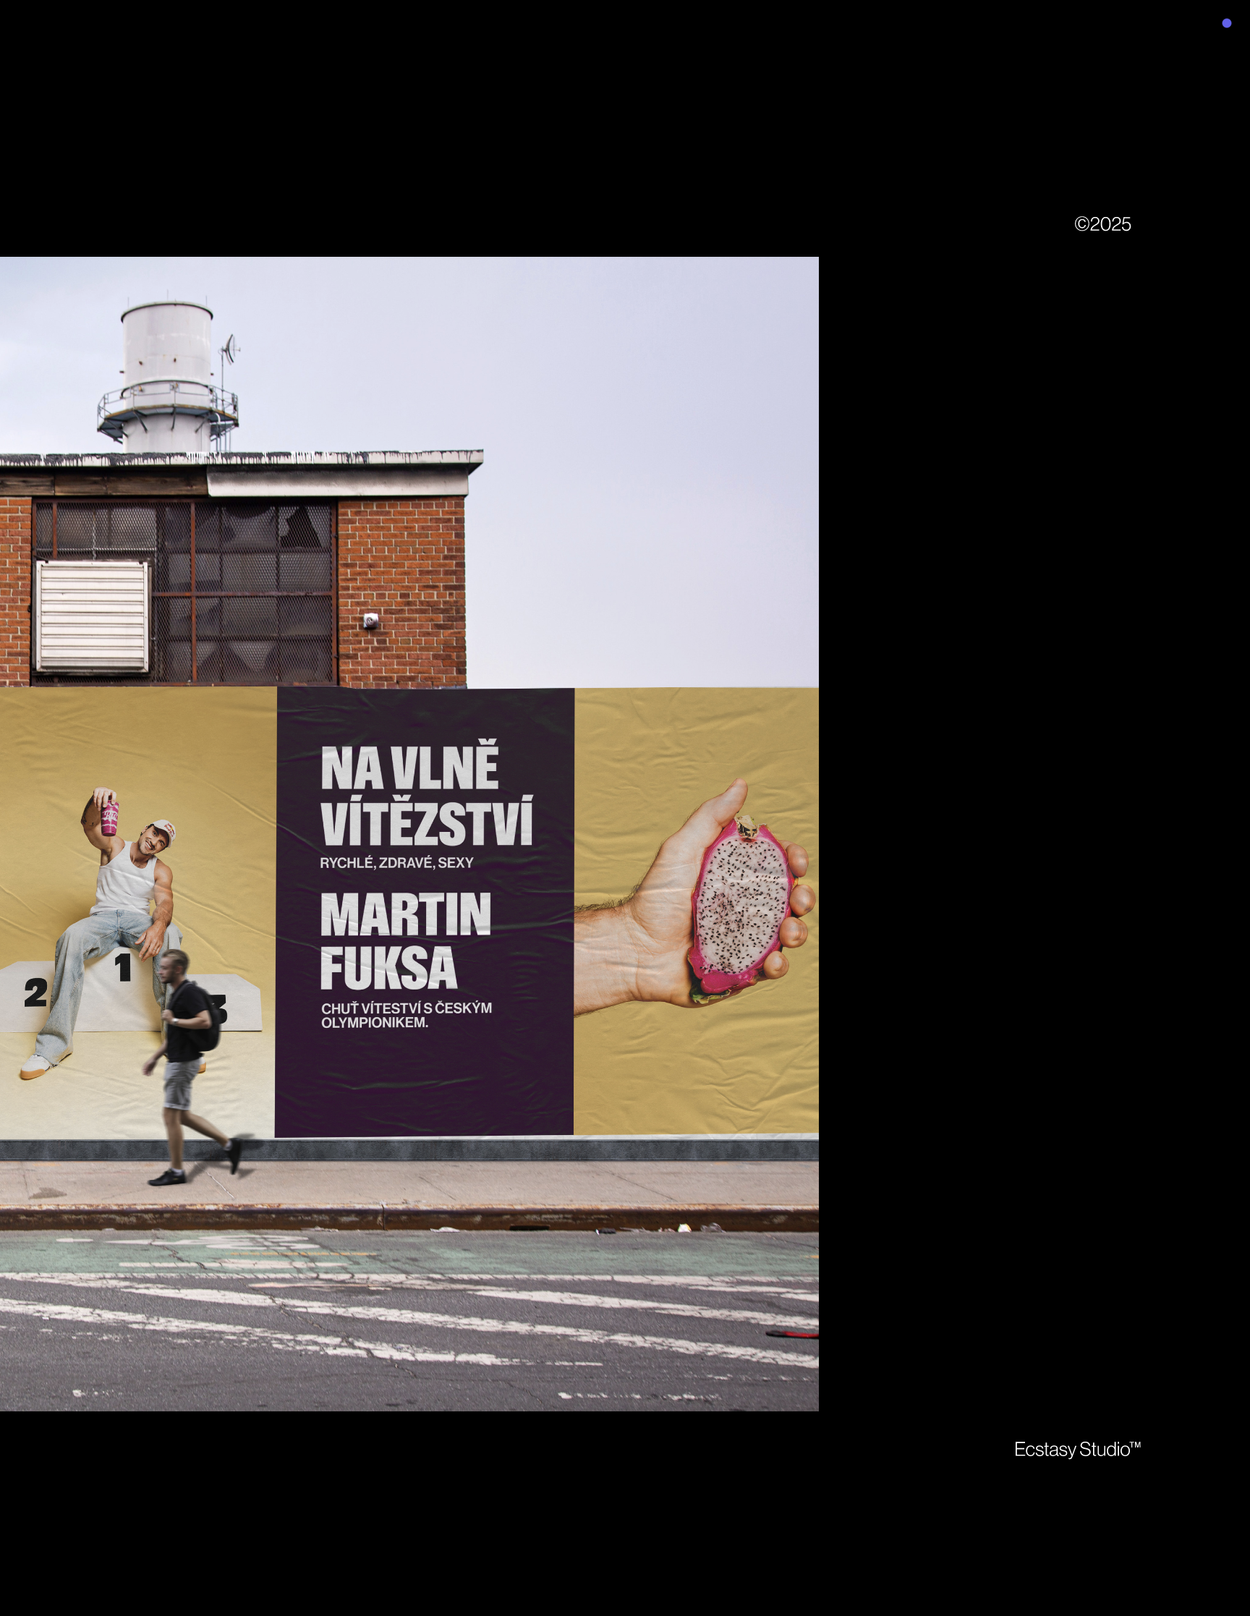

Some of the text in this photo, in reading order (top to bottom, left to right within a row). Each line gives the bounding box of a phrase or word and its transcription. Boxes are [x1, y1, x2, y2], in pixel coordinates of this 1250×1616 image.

[321, 738, 499, 790] NA VLNĚ
[320, 794, 534, 847] VÍTĚZSTVÍ
[320, 855, 474, 870] RYCHLÉ, ZDRAVÉ, SEXY
[320, 892, 491, 937] MARTIN
[114, 953, 131, 982] 1
[320, 945, 458, 991] FUKSA
[24, 978, 48, 1007] 2
[321, 1000, 492, 1015] CHUŤ VÍTESTVÍ S ČESKÝM
[321, 1016, 429, 1029] OLYMPIONIKEM.
